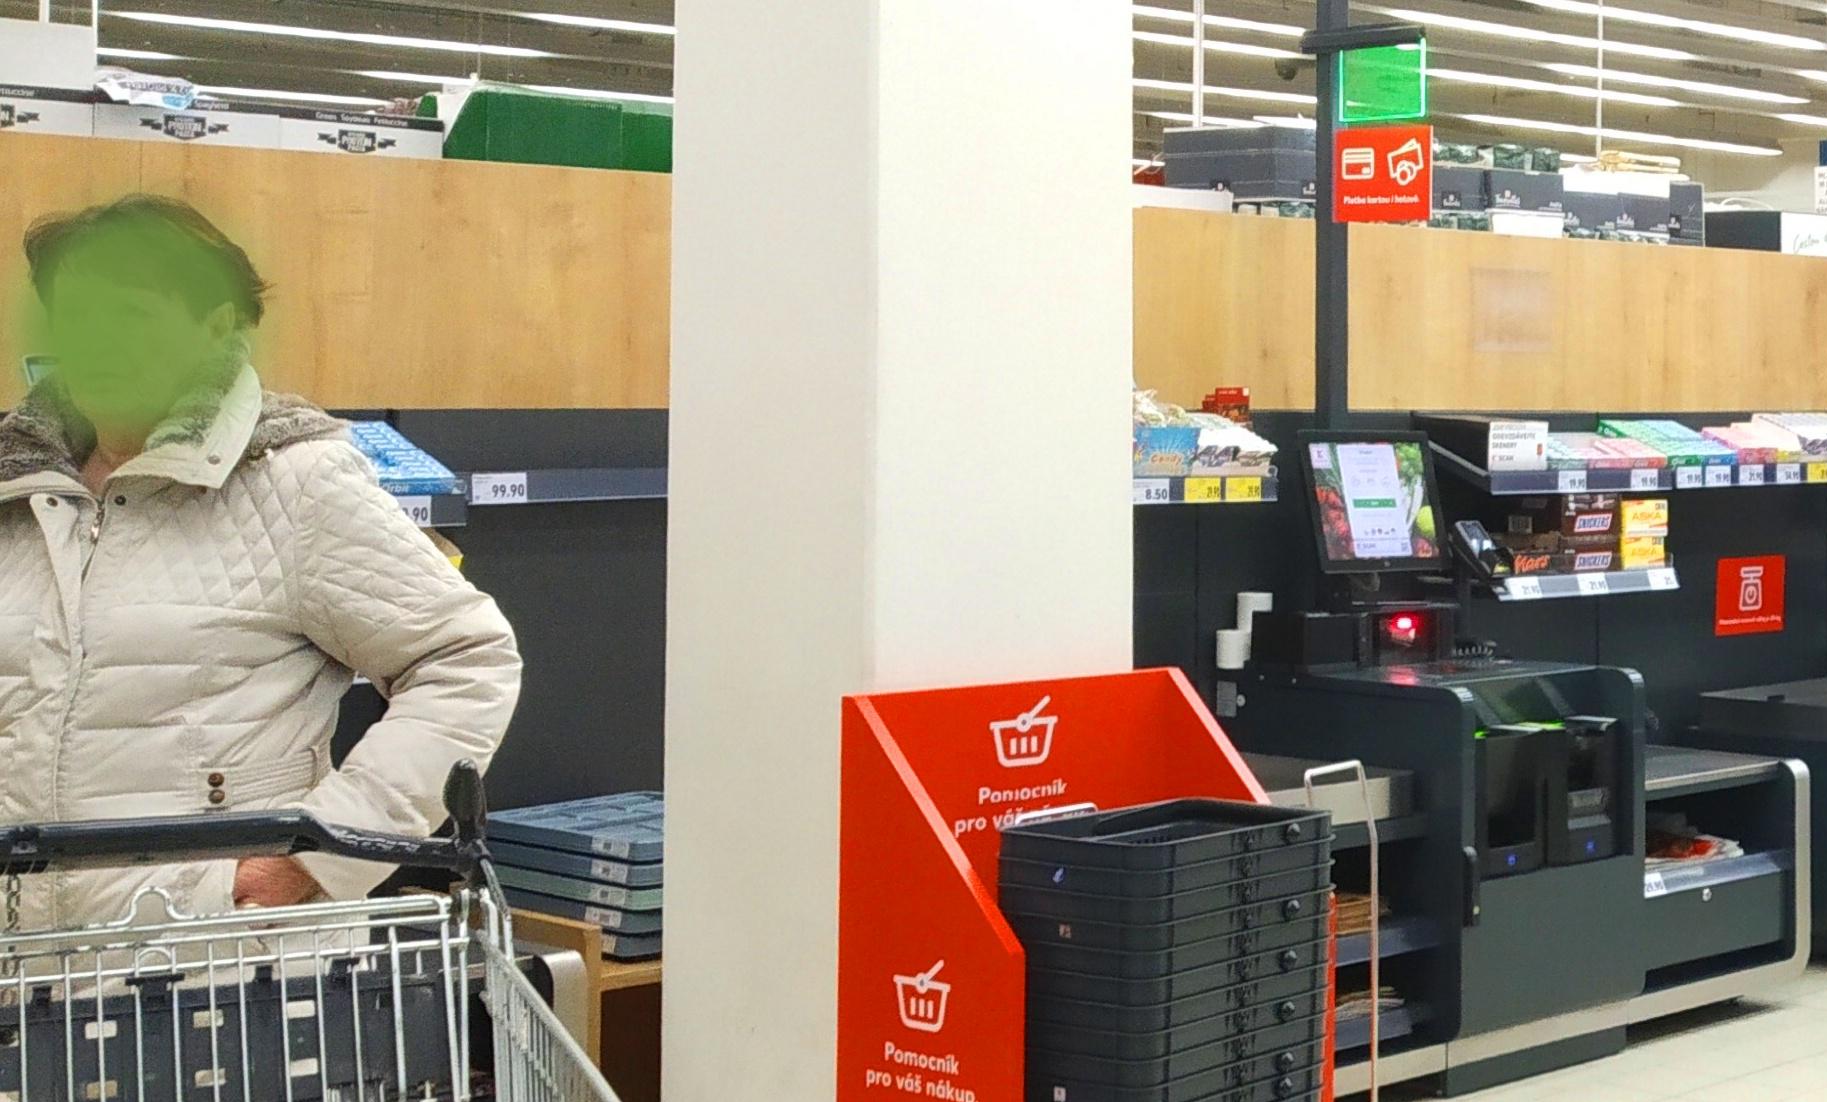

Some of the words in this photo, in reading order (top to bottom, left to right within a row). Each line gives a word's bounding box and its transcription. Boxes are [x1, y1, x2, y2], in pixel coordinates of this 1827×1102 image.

[492, 484, 525, 498] 99.90
[1145, 488, 1168, 500] 8.50
[1577, 515, 1611, 531] SNICKERS
[1577, 553, 1611, 570] SNICKERS
[978, 777, 1069, 805] Pomocník
[954, 816, 988, 839] pro
[884, 1041, 960, 1076] Pomocník
[866, 1069, 893, 1089] pro
[896, 1072, 922, 1095] váš
